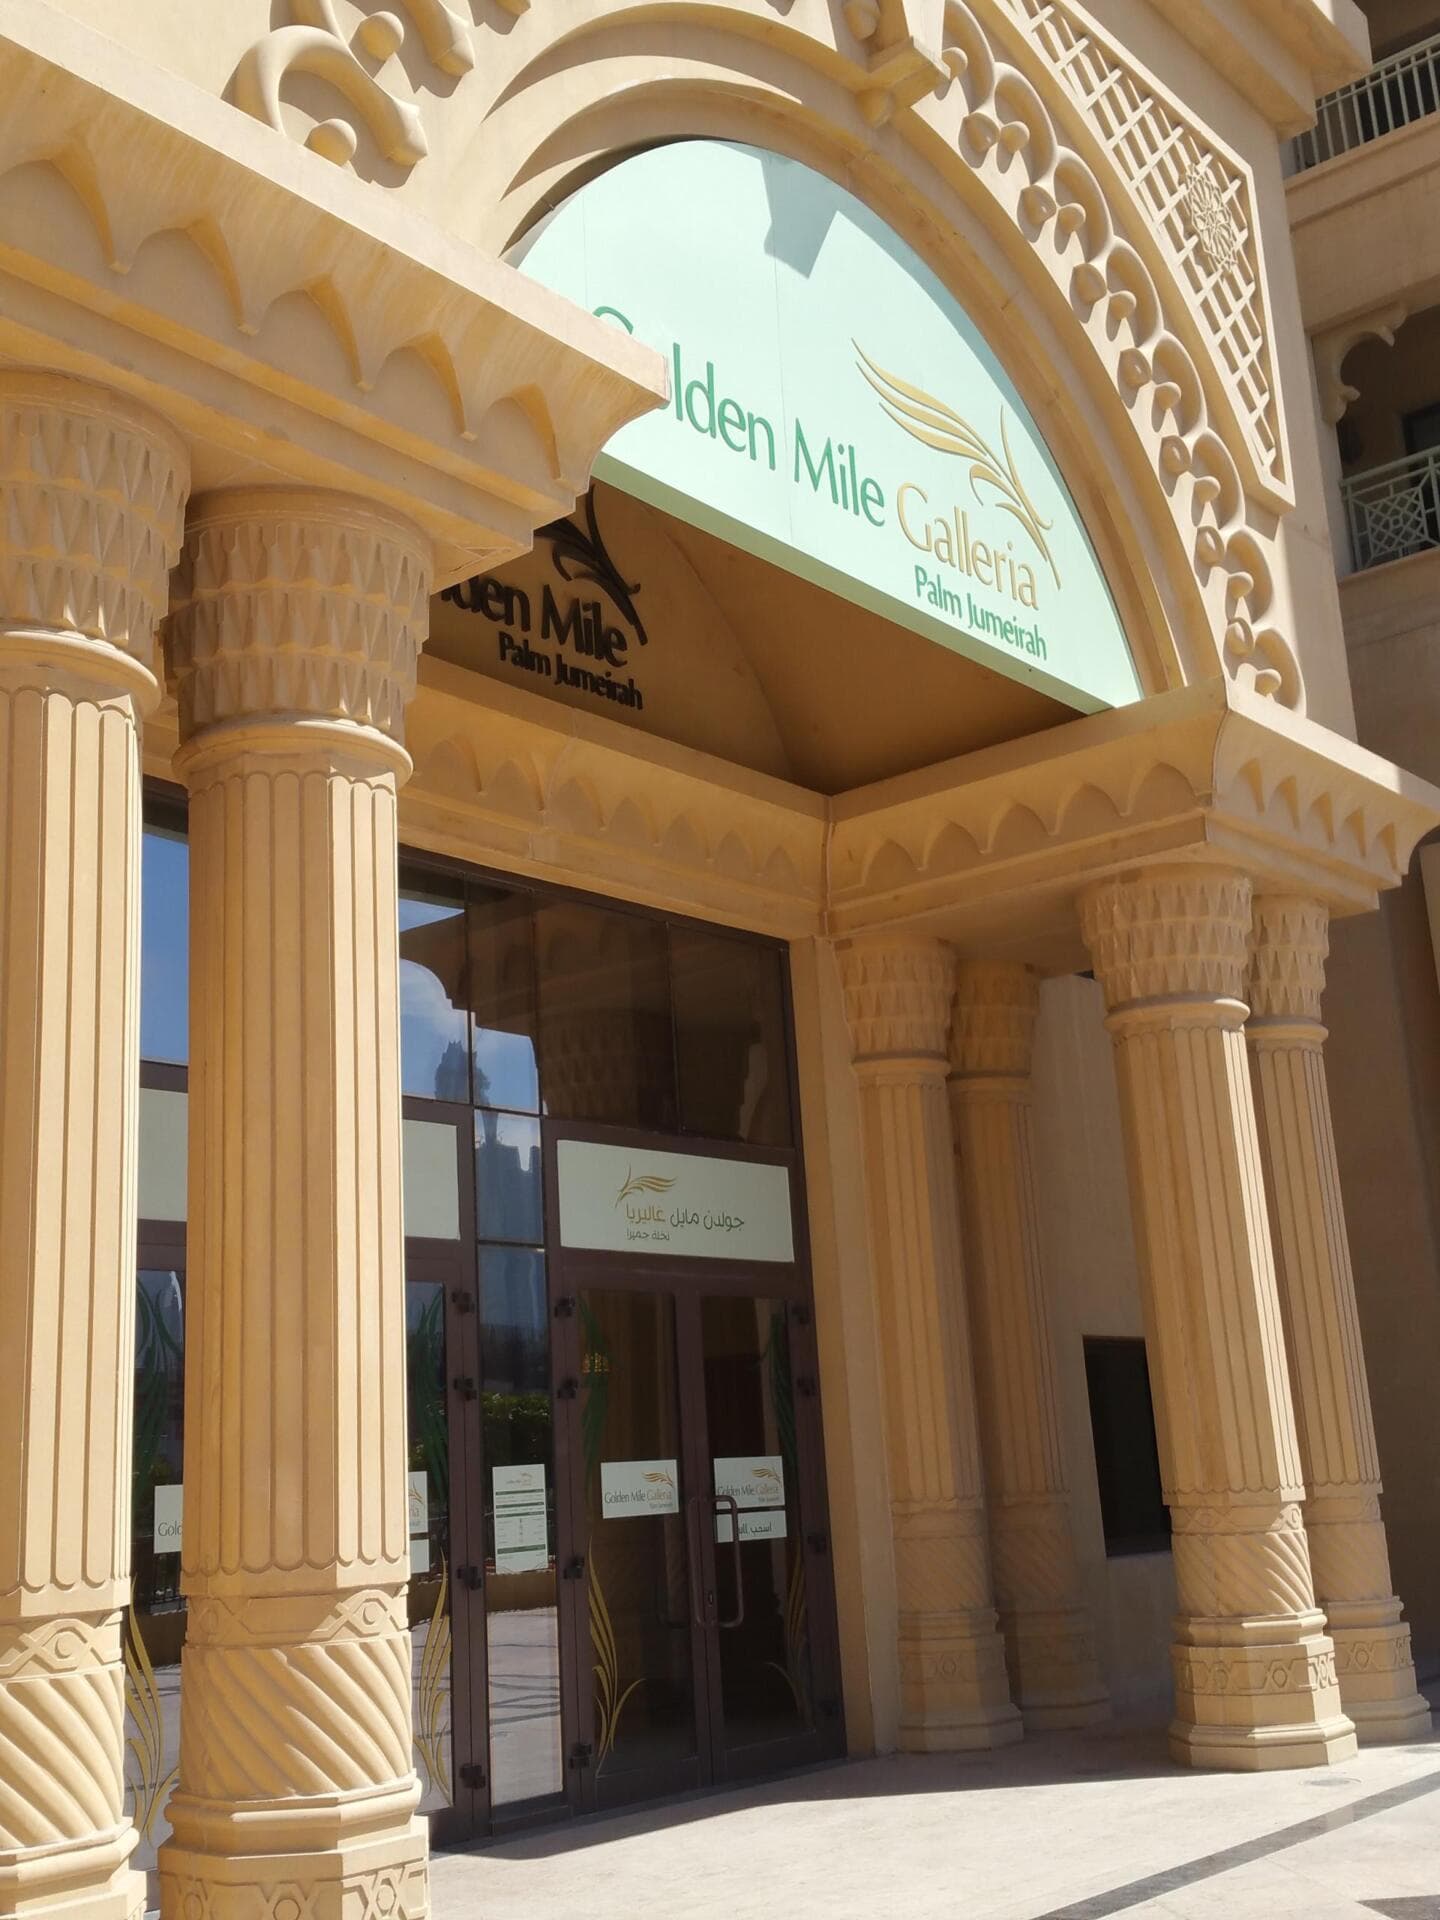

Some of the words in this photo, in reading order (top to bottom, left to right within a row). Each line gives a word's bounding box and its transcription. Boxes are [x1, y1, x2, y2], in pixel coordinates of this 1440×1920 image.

[593, 306, 776, 471] lden
[794, 417, 886, 527] Mile
[897, 482, 1040, 611] Galleria
[541, 583, 628, 668] Mile
[914, 564, 963, 619] Palm
[967, 592, 1048, 661] Jumeirah
[498, 630, 552, 676] Palm
[554, 654, 644, 710] Jumeirah
[669, 1207, 700, 1227] مايل
[604, 1489, 630, 1504] Golden
